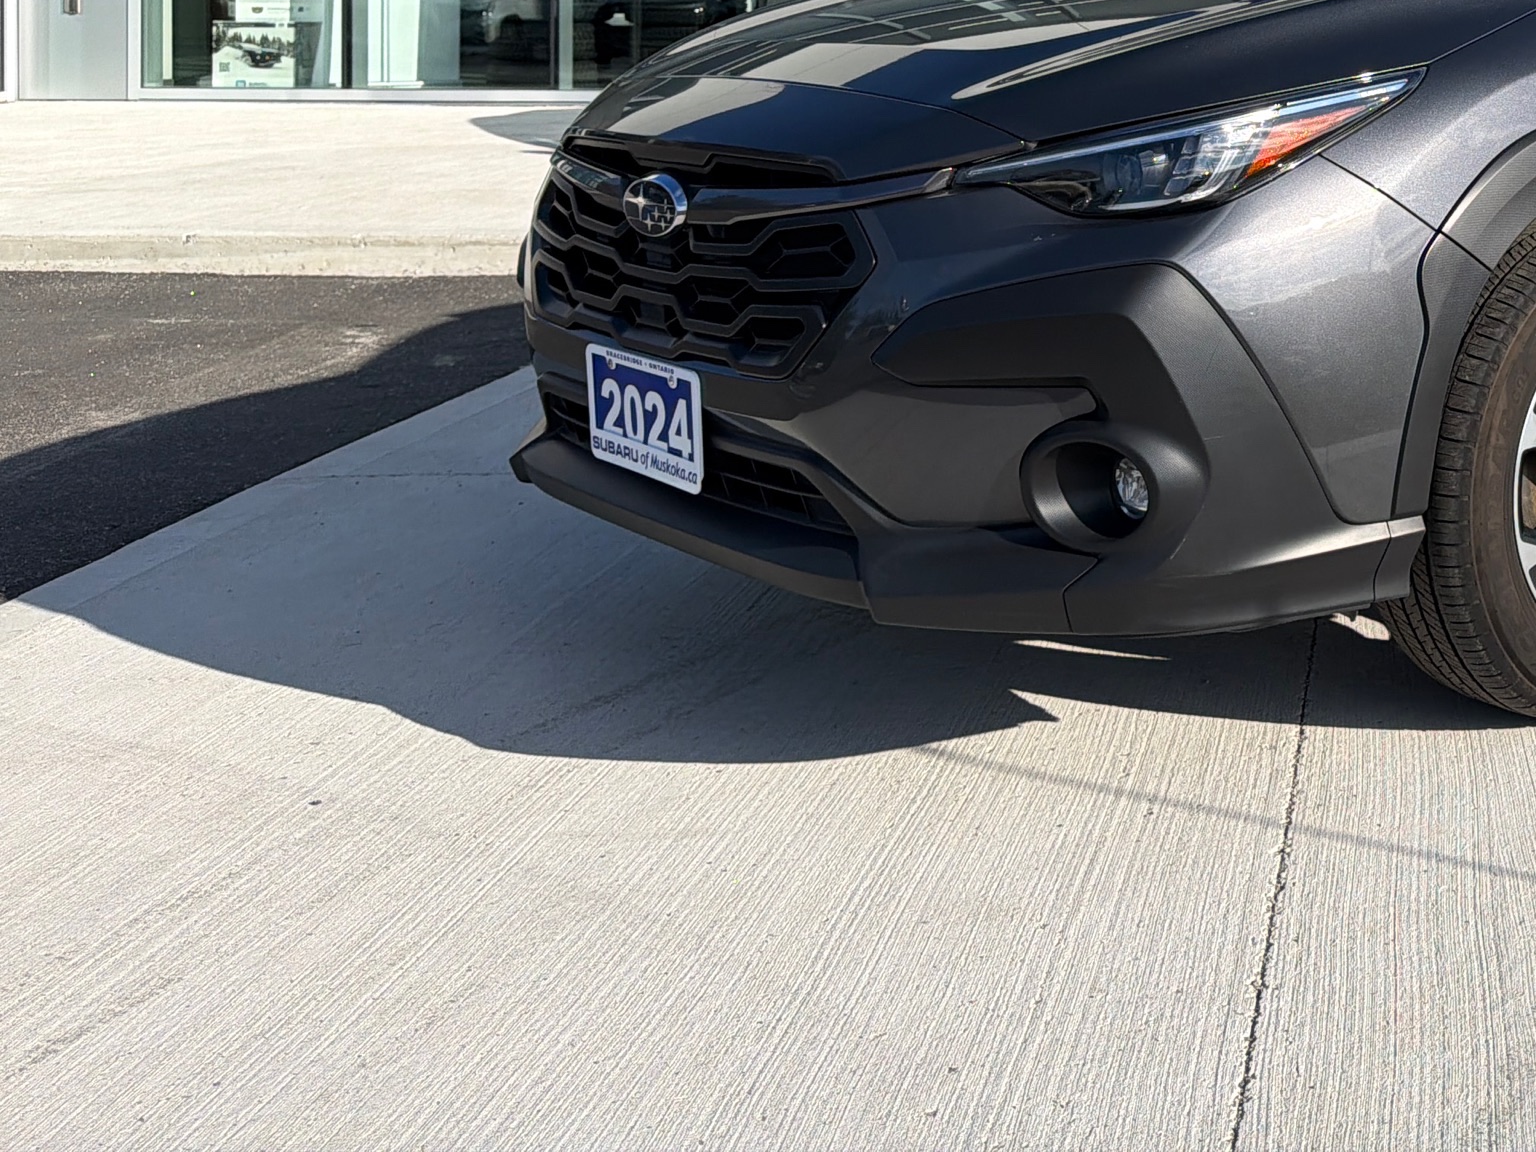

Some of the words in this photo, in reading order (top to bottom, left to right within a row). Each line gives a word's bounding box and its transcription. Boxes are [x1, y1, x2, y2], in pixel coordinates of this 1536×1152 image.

[605, 350, 643, 366] BRACEBRIDGE
[648, 362, 675, 375] ONTARIO
[601, 378, 691, 460] 2024
[592, 435, 639, 463] SUBARU
[640, 451, 650, 470] of
[650, 453, 698, 485] Muskoka.ca
